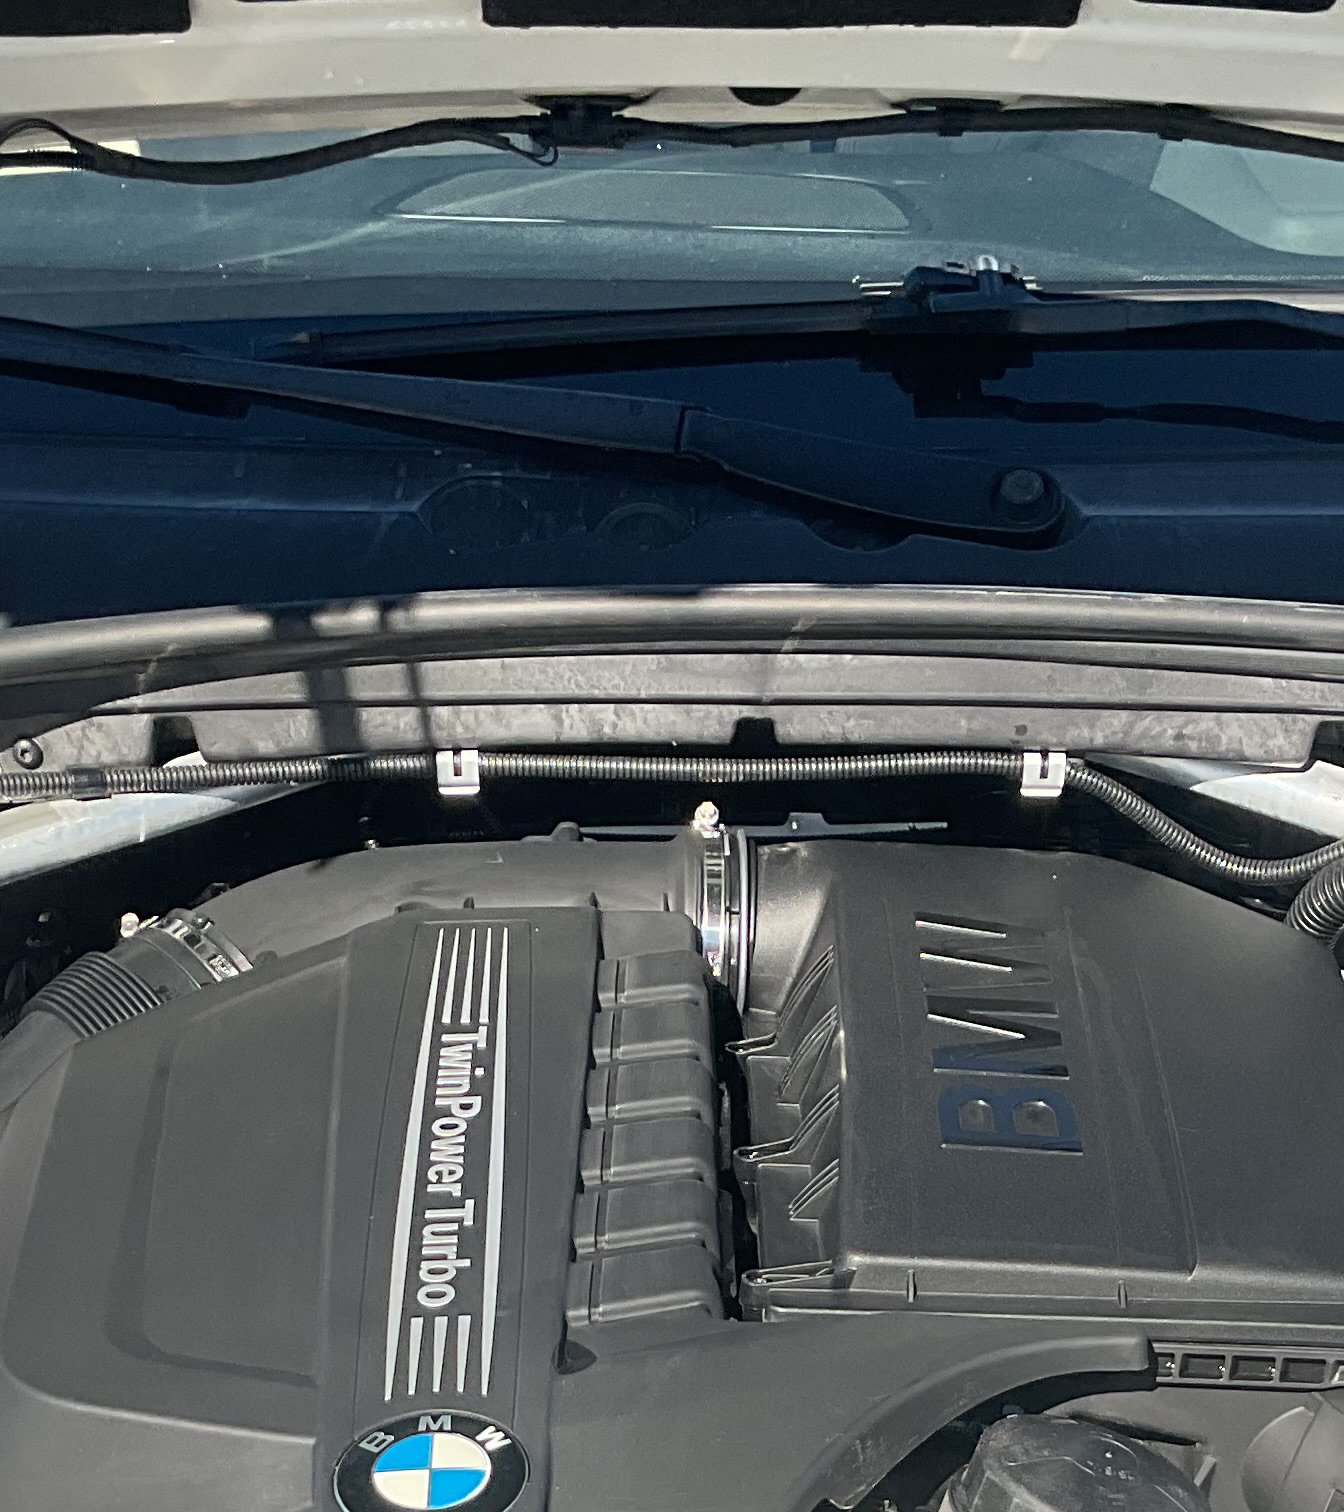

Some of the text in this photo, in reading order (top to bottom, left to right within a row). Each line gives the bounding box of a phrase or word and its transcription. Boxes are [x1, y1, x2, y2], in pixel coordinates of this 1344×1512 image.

[913, 911, 1085, 1156] BMW
[417, 1025, 488, 1308] TwinPower Turbo
[358, 1414, 513, 1453] BMW
